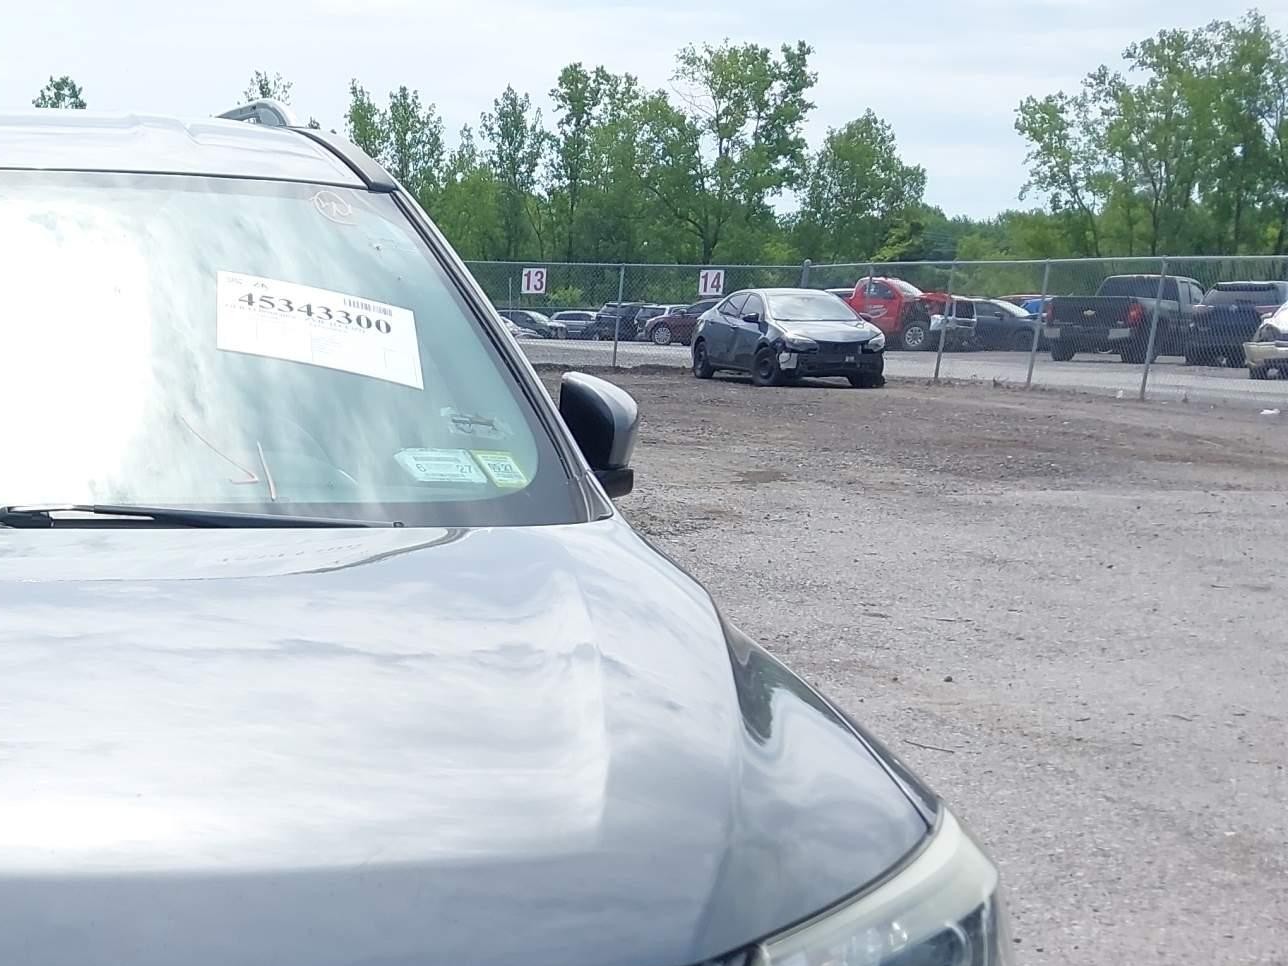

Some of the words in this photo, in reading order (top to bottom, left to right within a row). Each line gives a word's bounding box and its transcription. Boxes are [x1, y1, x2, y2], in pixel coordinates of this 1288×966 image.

[523, 270, 545, 292] 13
[701, 272, 722, 293] 14
[238, 292, 392, 334] 45343300
